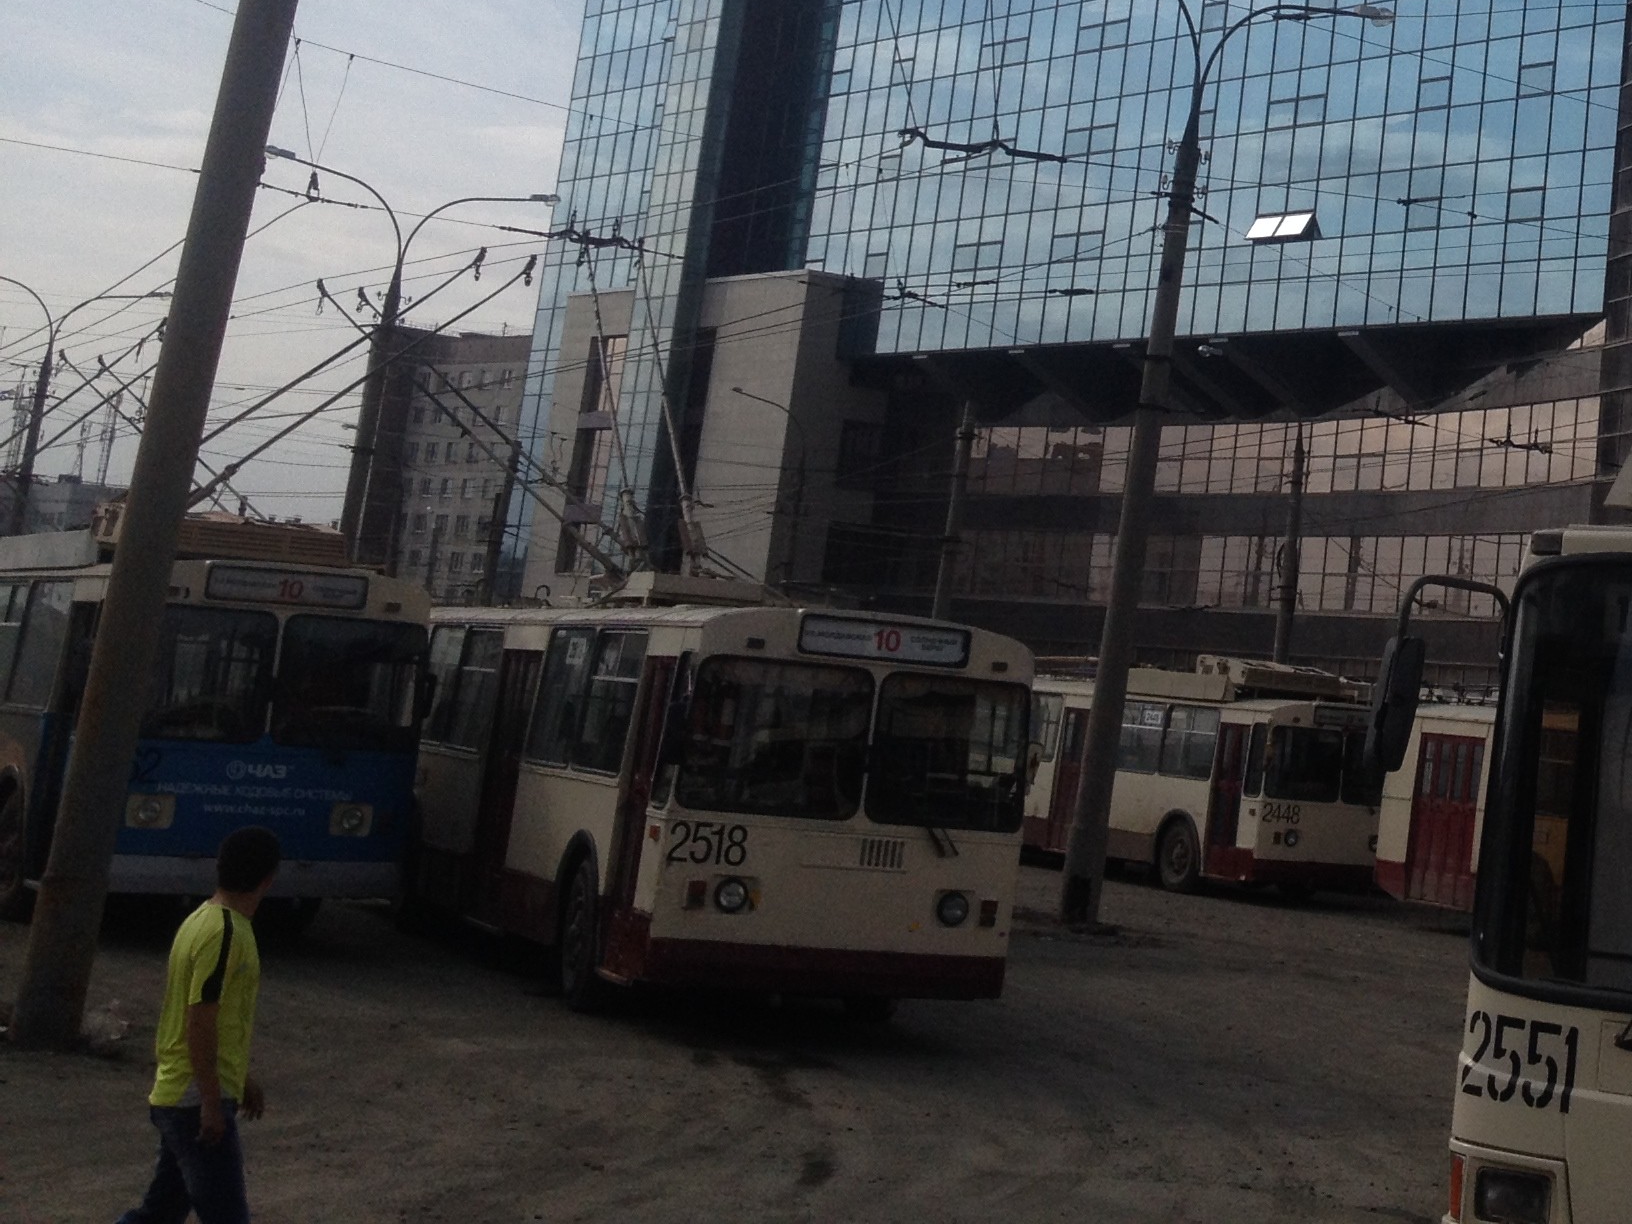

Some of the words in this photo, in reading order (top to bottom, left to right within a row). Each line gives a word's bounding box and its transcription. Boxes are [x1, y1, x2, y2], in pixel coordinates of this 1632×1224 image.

[279, 579, 304, 599] 10
[874, 629, 901, 652] 10
[248, 764, 287, 779] ЧАЗ
[1262, 802, 1300, 824] 2448
[666, 820, 747, 866] 2518
[1461, 1010, 1578, 1114] 2551
